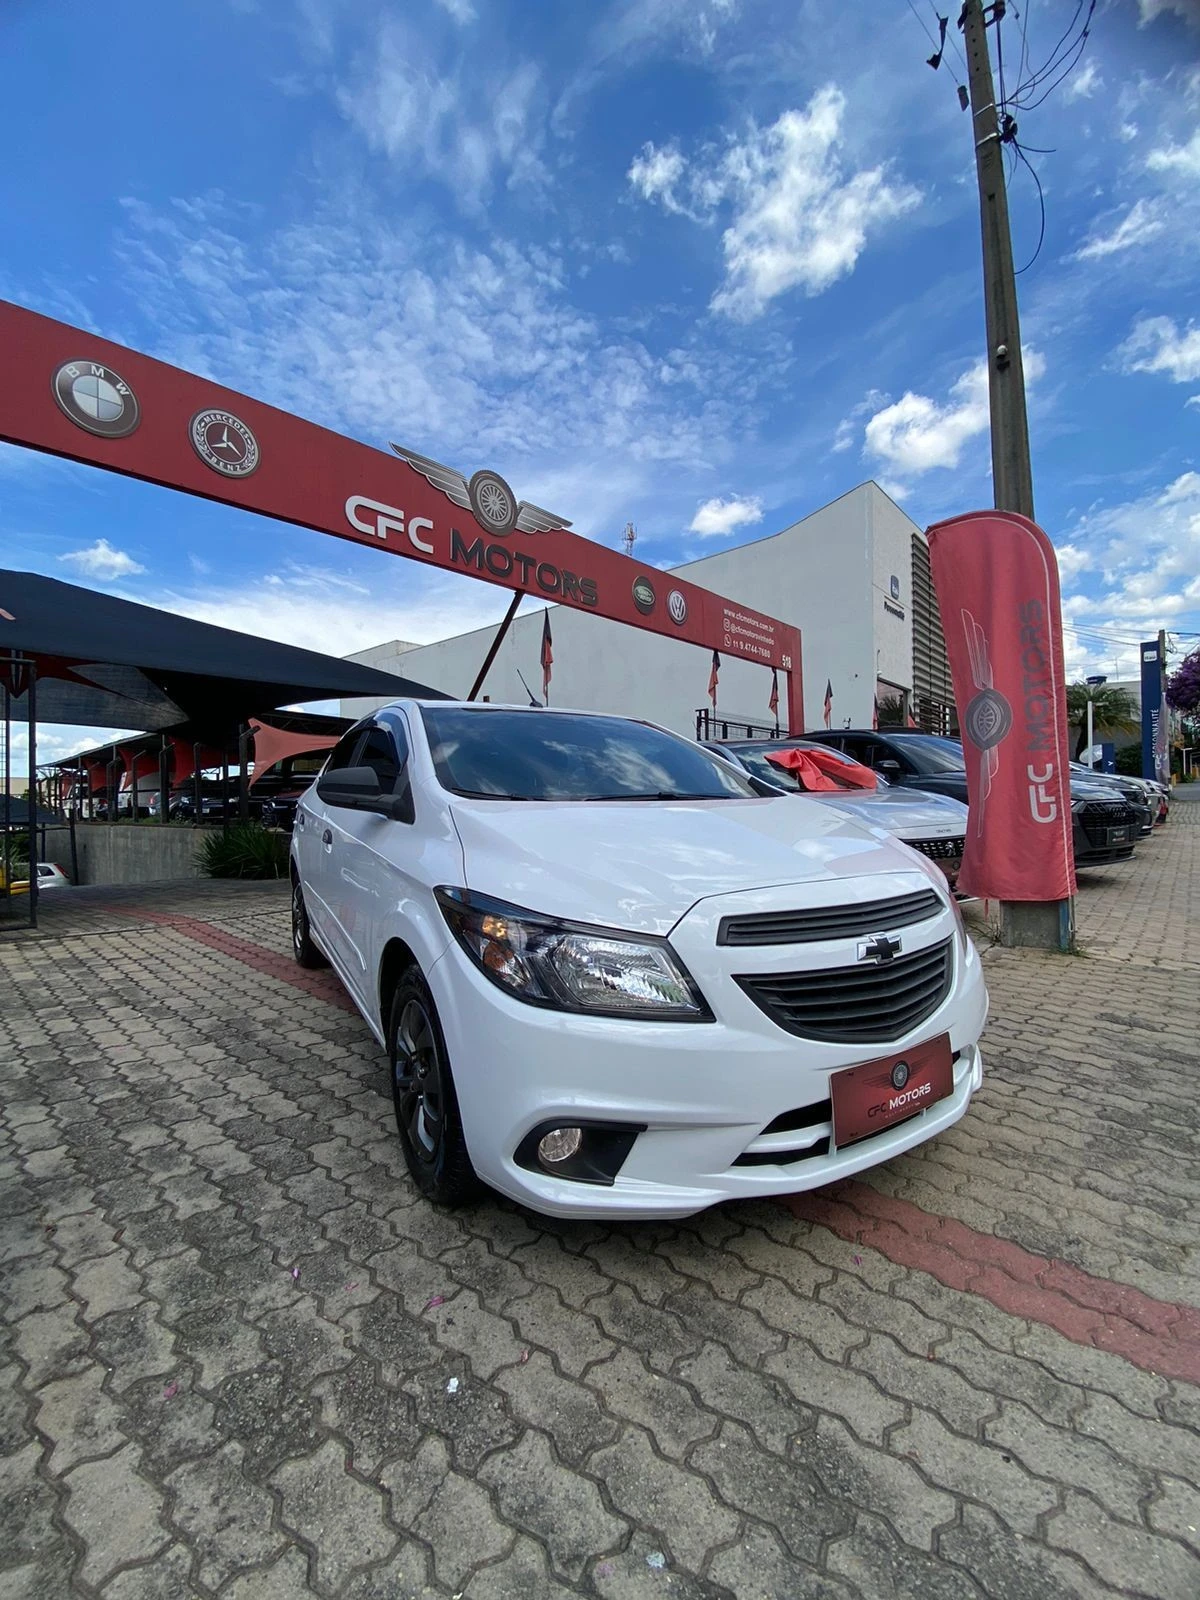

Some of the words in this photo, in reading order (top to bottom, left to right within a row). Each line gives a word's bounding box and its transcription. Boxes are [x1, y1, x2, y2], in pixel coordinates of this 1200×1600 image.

[65, 365, 130, 395] BMW
[203, 414, 249, 439] MERCEDES
[211, 456, 242, 472] BENZ
[345, 495, 434, 554] CFC
[450, 528, 599, 607] MOTORS
[1020, 599, 1051, 751] MOTORS
[1027, 763, 1056, 824] CFC
[867, 1102, 887, 1118] CFC
[889, 1082, 932, 1110] MOTORS
